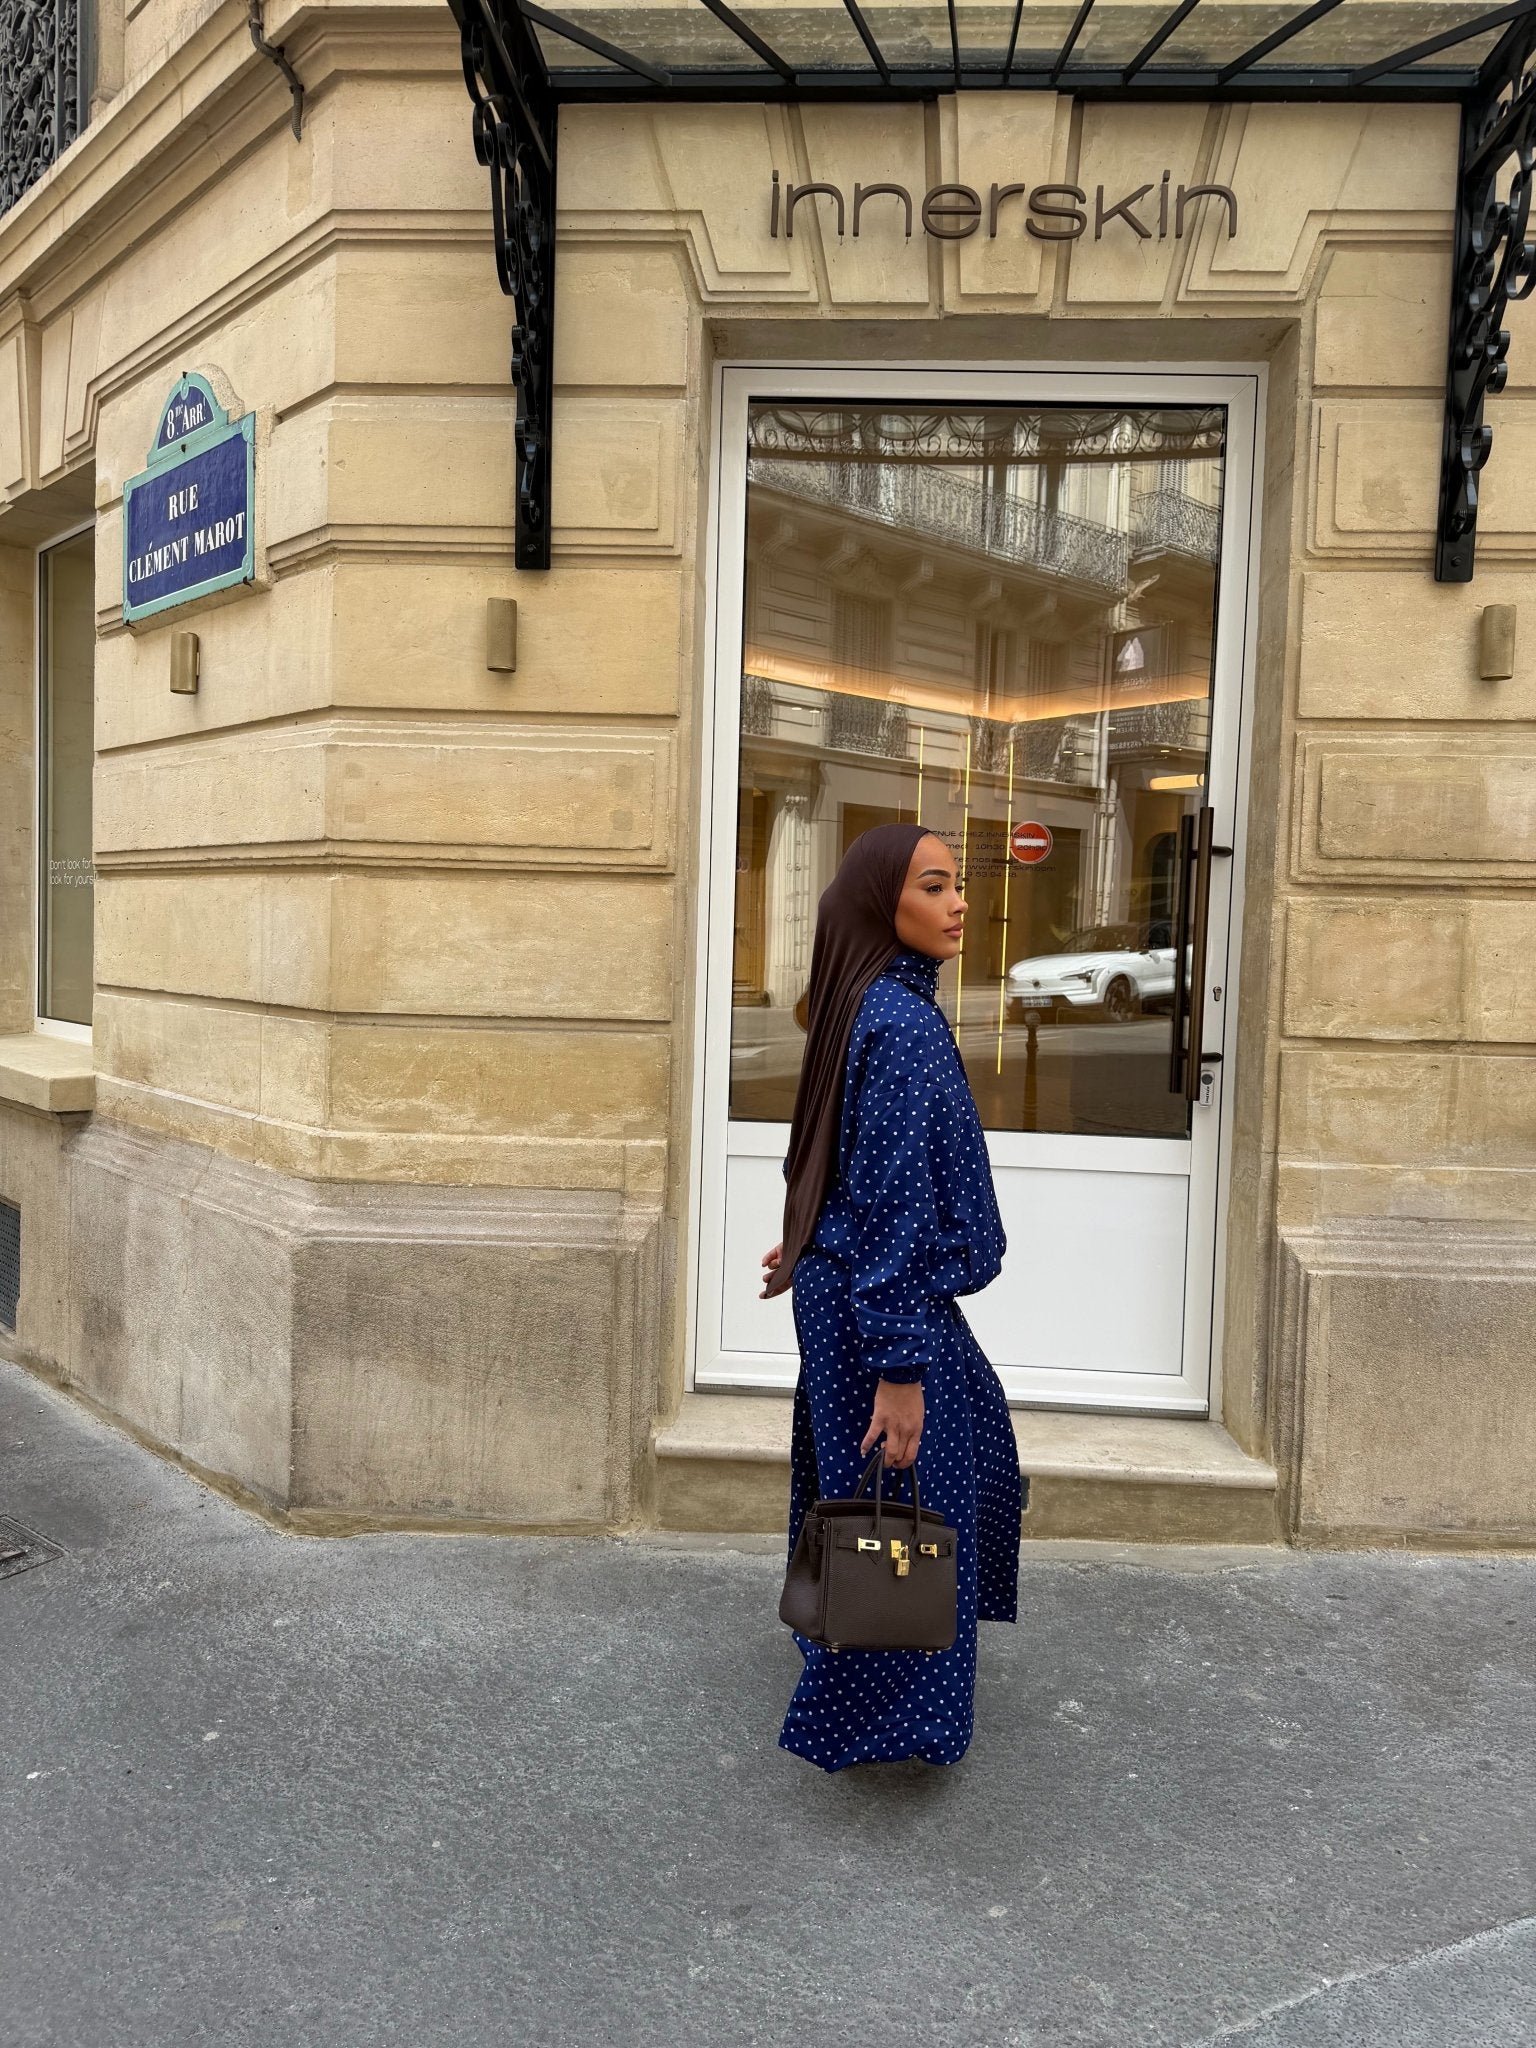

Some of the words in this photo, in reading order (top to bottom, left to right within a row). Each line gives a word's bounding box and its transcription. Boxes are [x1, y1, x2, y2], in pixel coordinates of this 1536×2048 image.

[771, 169, 1238, 240] innerskin
[168, 483, 199, 521] RUE
[129, 541, 189, 583] CLÉMENT
[194, 512, 245, 557] MAROT
